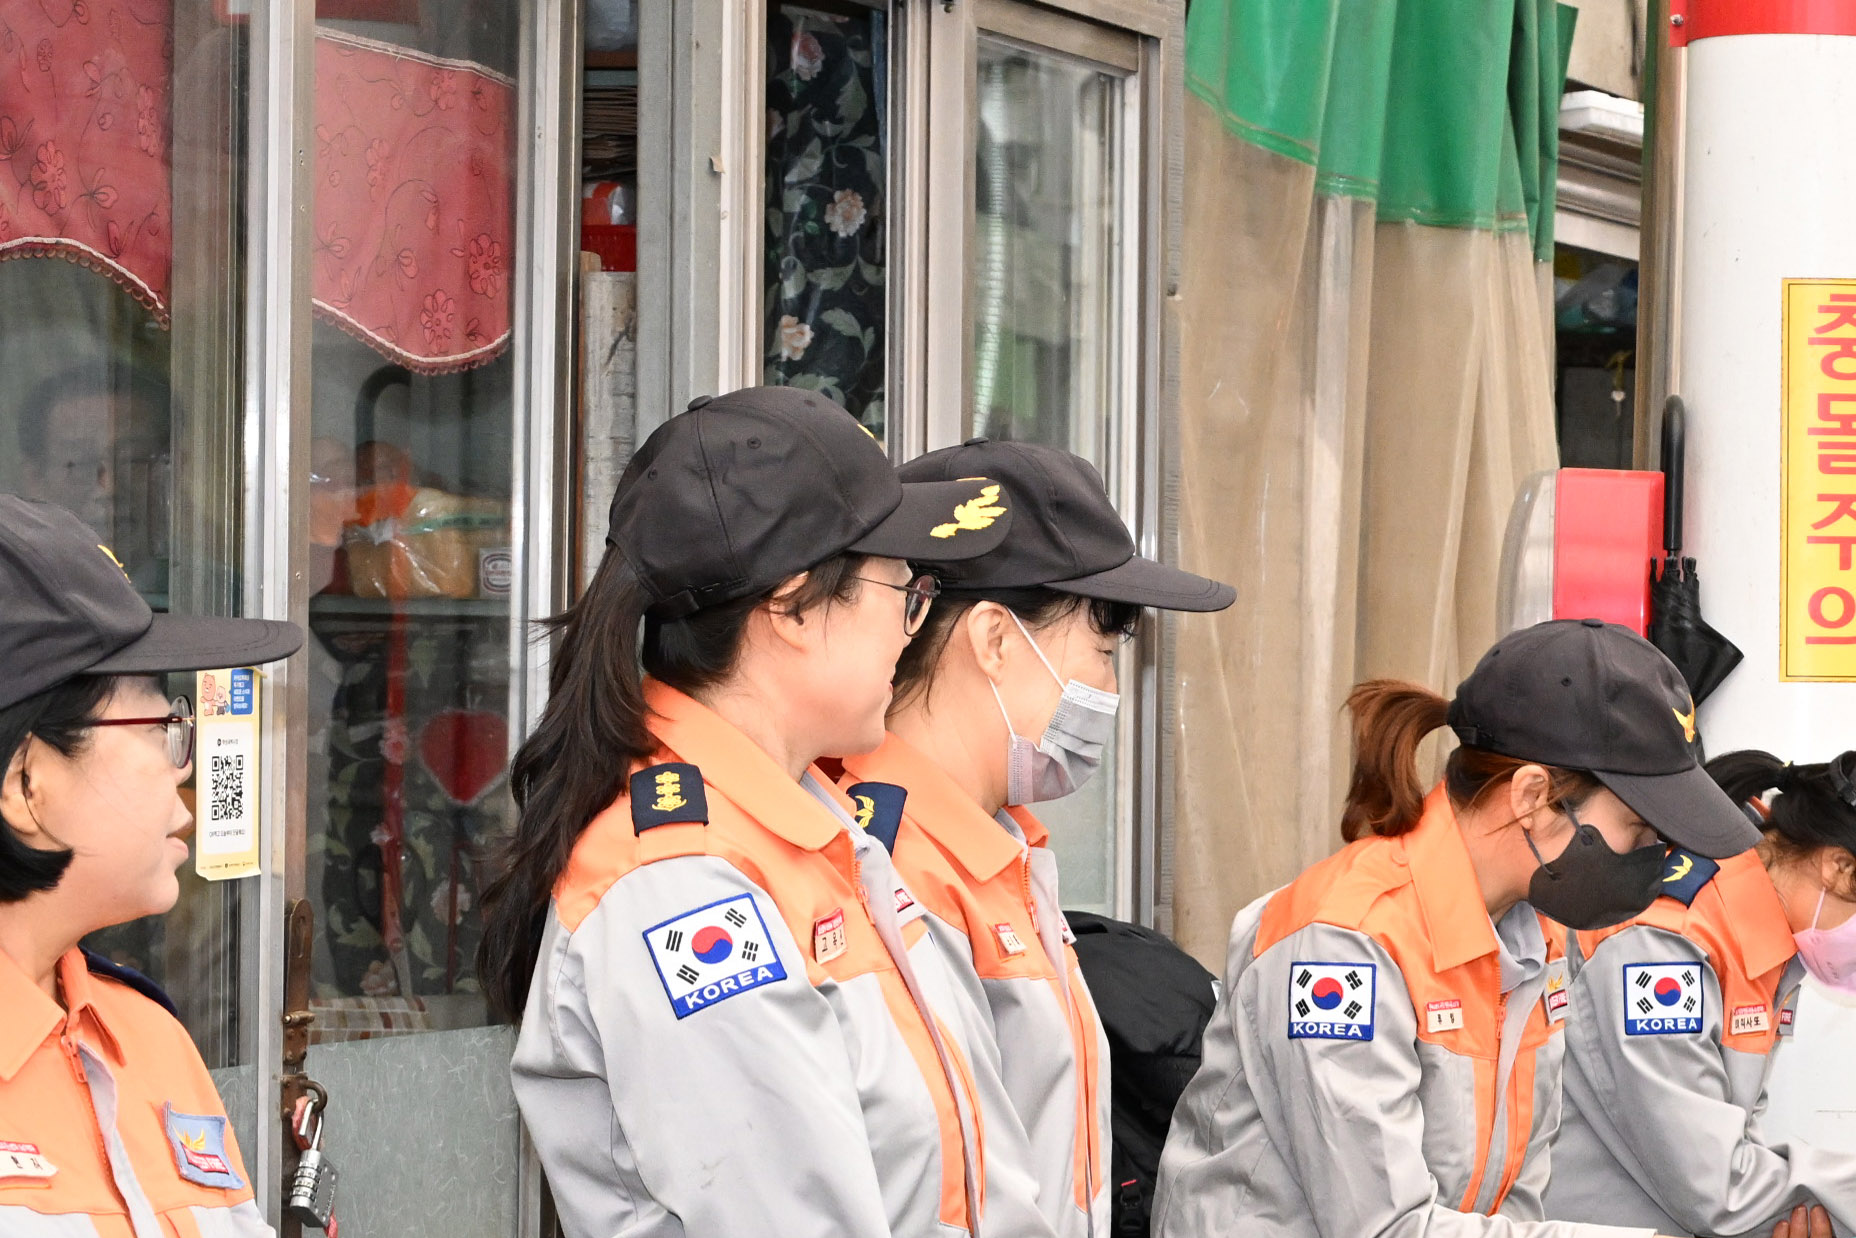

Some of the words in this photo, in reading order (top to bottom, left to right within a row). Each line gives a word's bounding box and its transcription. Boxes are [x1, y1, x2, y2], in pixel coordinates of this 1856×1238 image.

[684, 965, 774, 1009] KOREA
[1293, 1022, 1363, 1037] KOREA
[1636, 1018, 1698, 1032] KOREA
